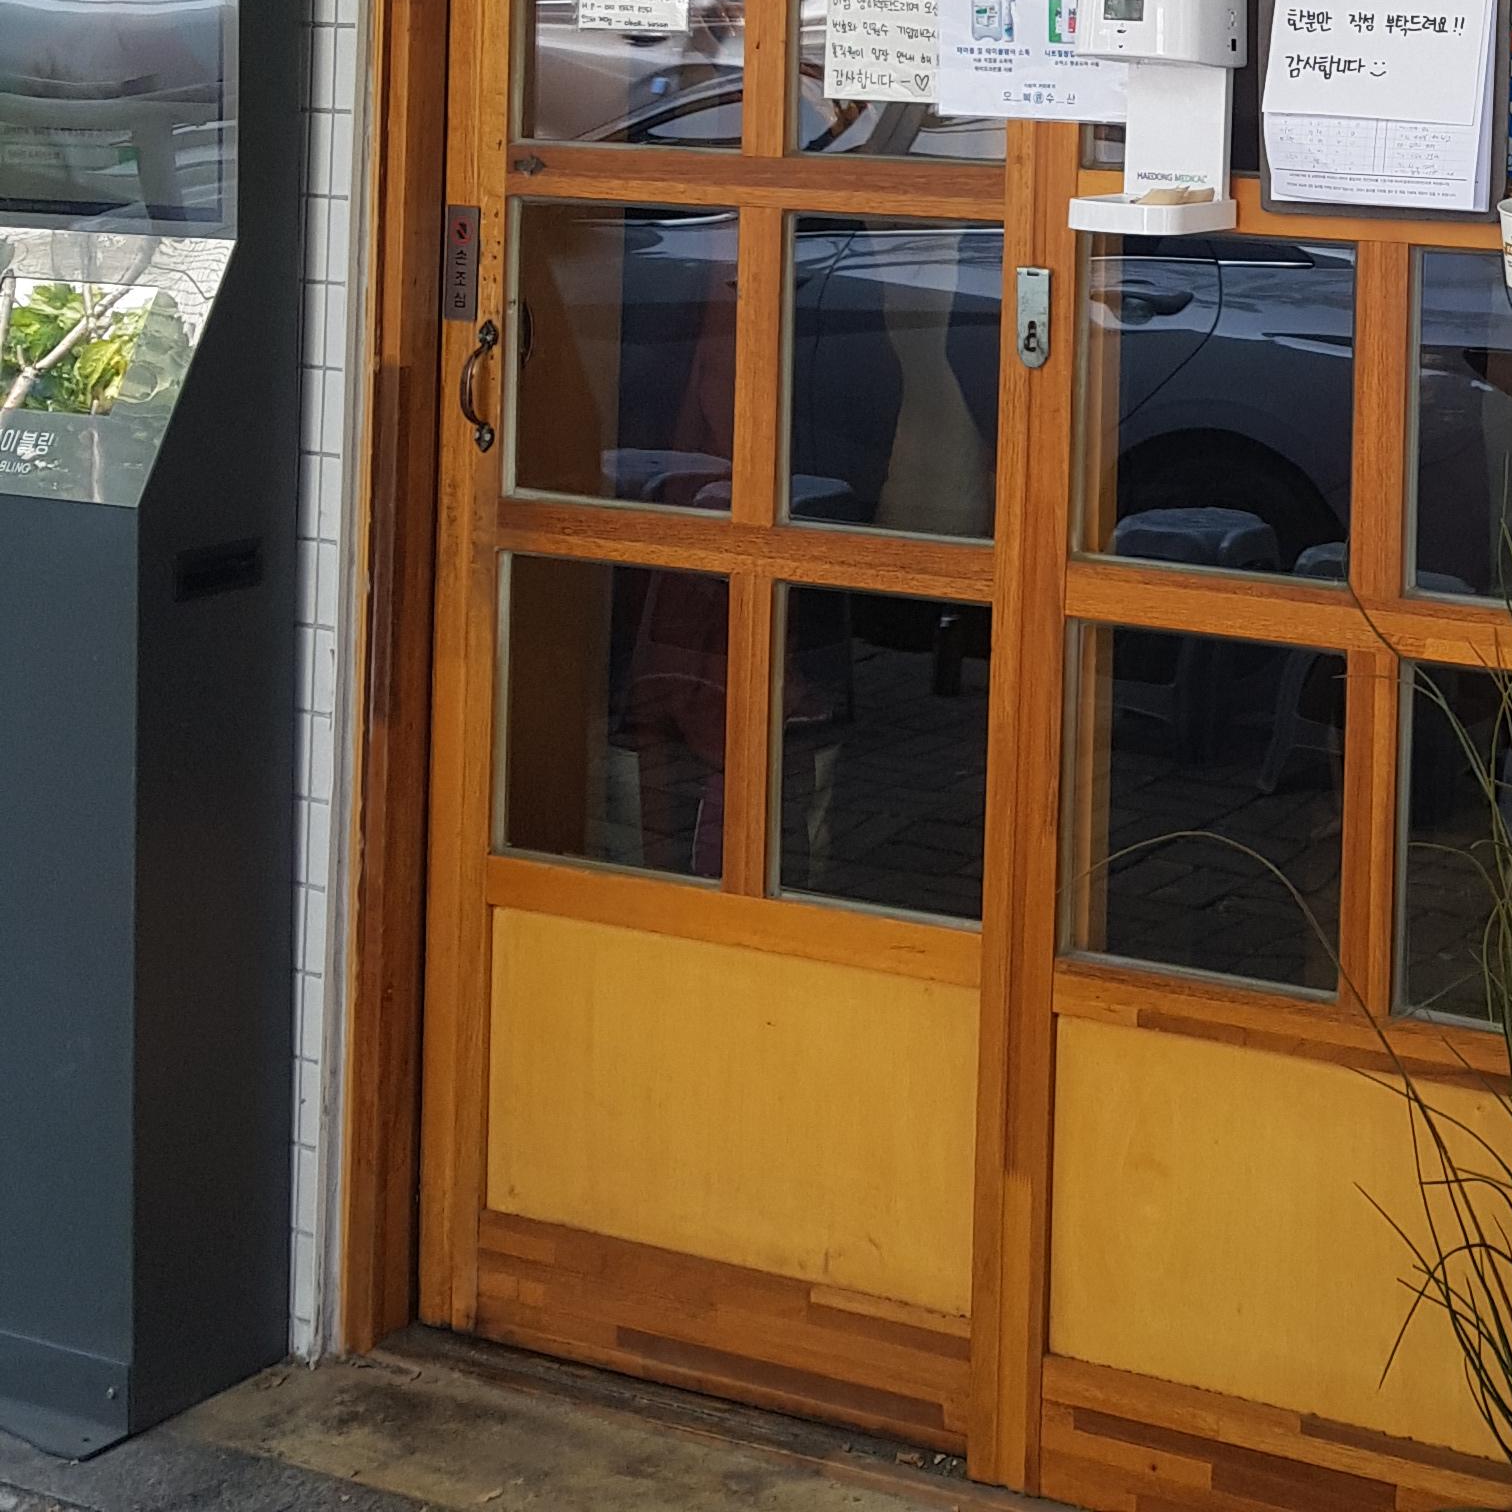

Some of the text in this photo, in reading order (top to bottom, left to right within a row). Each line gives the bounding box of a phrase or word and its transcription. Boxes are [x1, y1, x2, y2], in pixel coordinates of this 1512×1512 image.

[1287, 8, 1333, 33] 한분만
[1348, 11, 1375, 34] 작성
[1285, 54, 1366, 80] 감사합니다
[0, 429, 55, 460] 이블링
